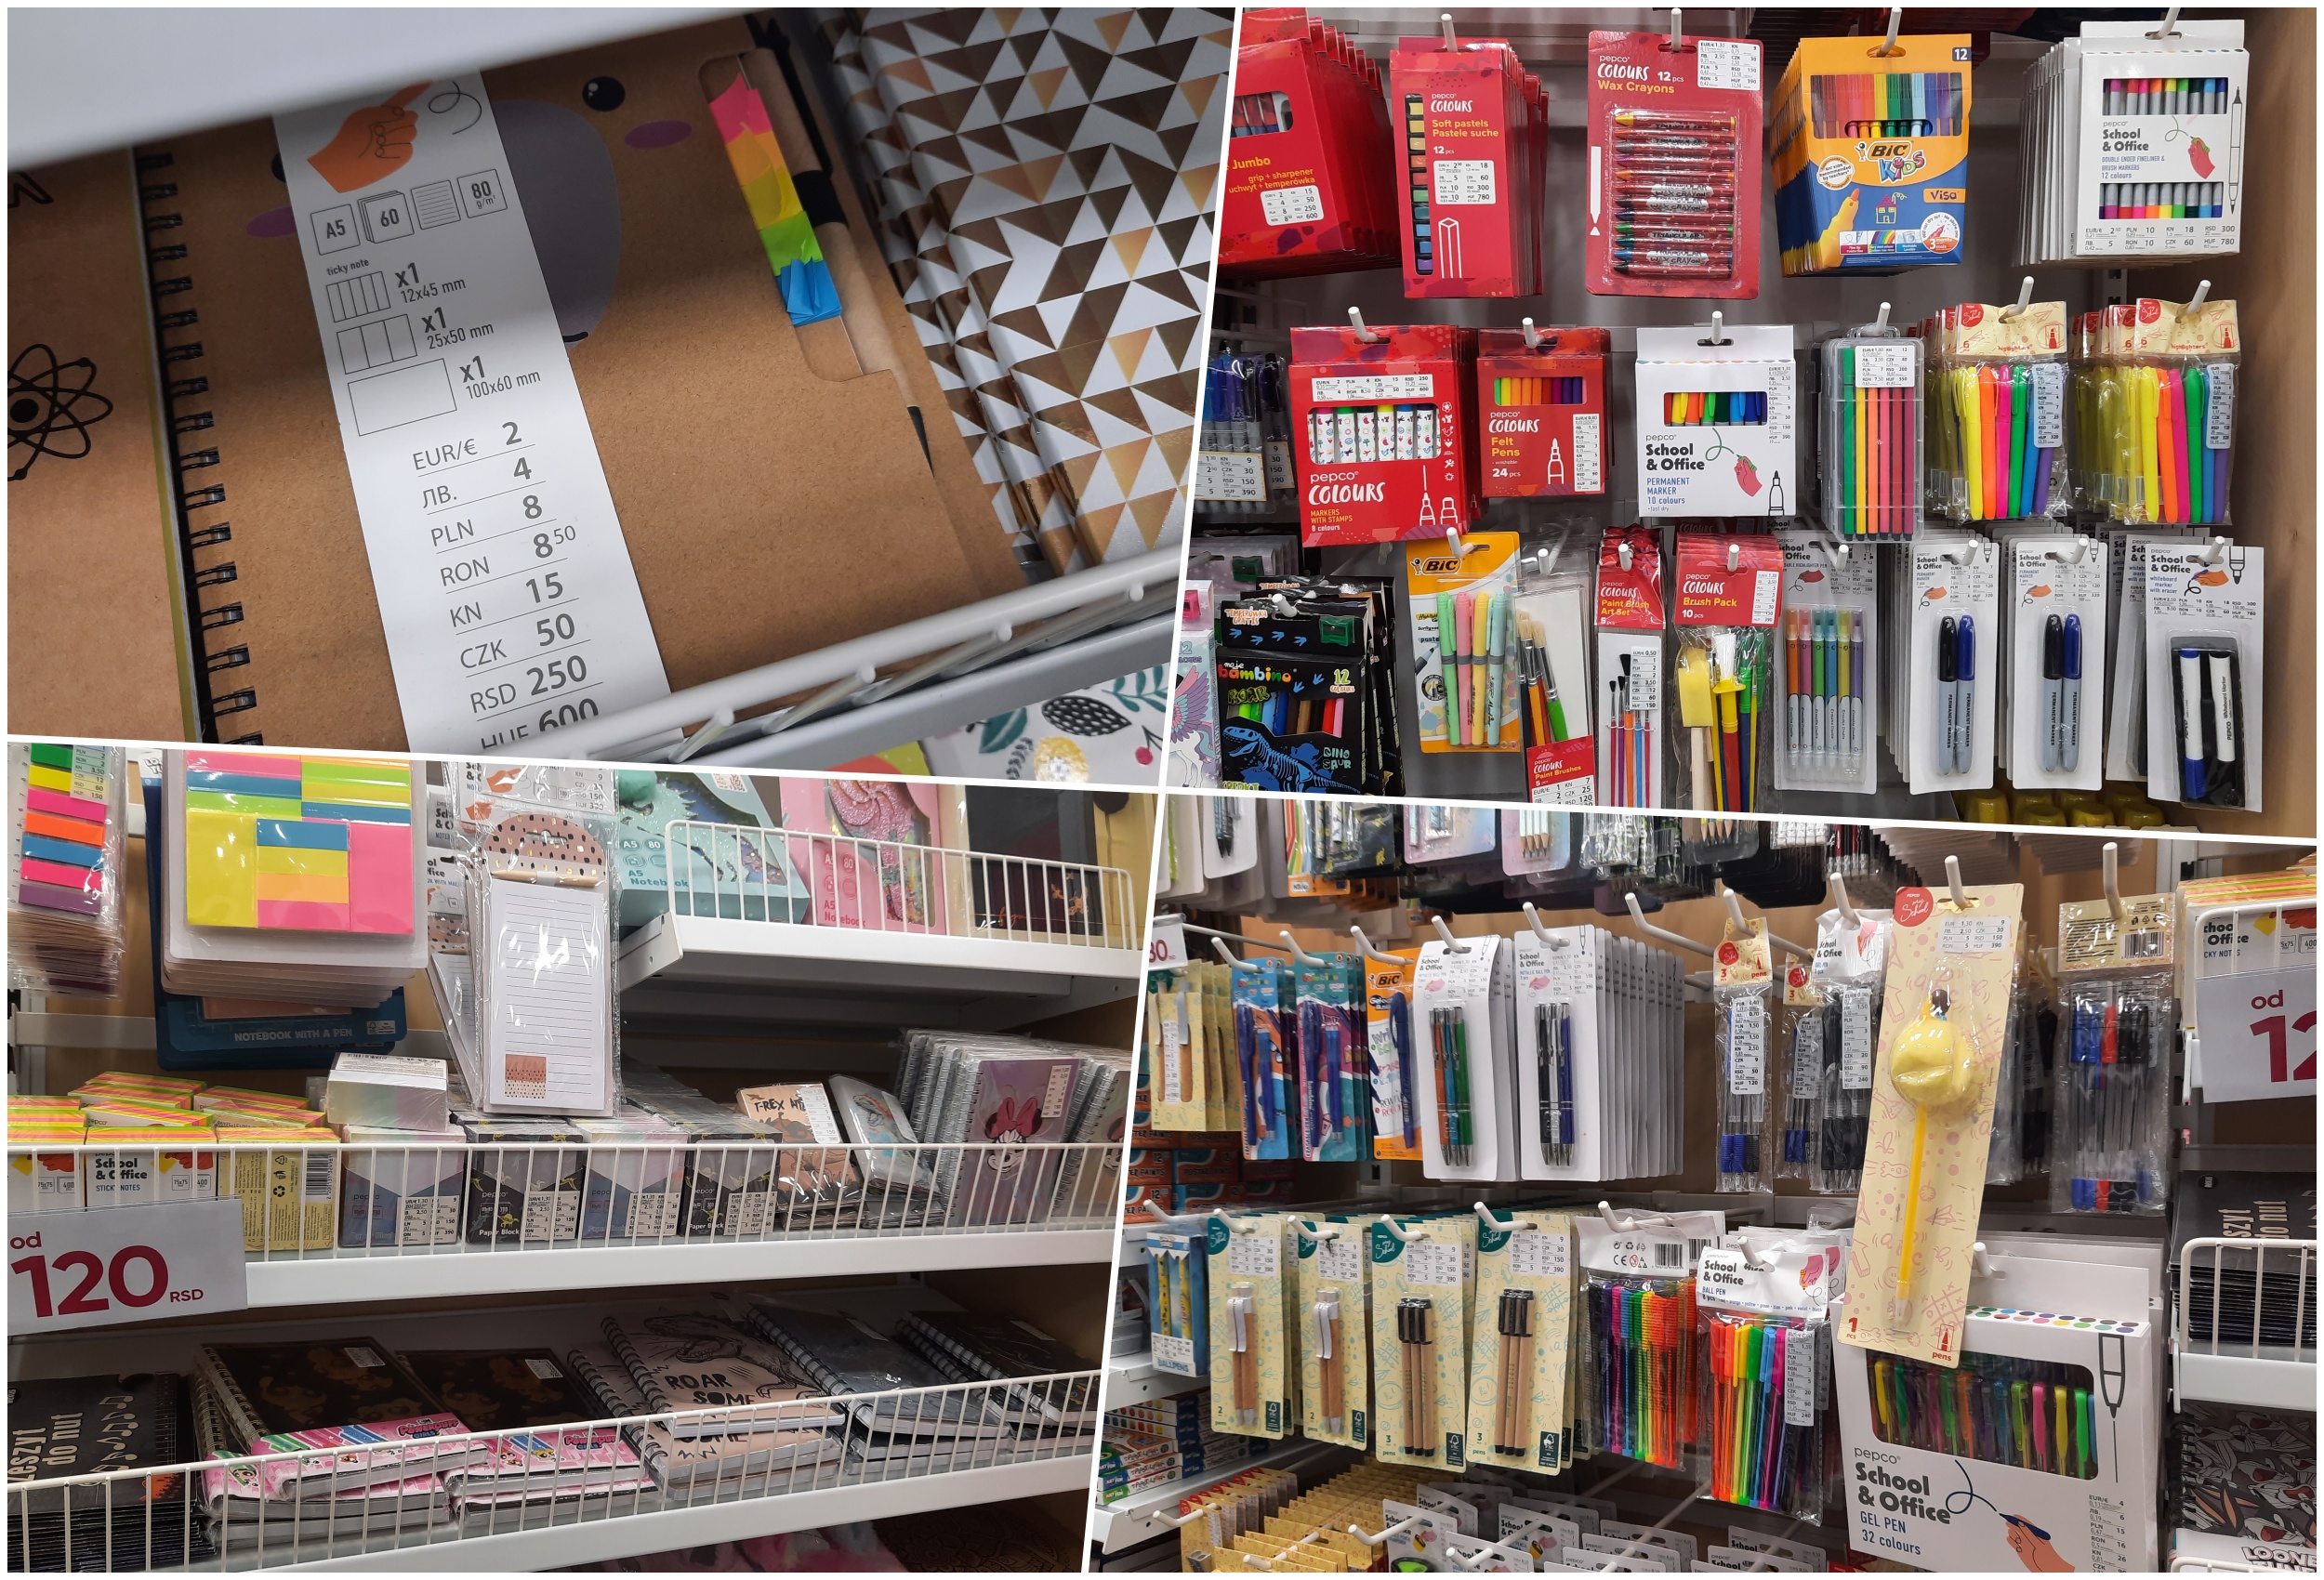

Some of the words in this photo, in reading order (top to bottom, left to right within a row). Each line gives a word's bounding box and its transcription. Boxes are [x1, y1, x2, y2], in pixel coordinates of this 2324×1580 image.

[1954, 48, 1967, 59] 12
[1597, 63, 1649, 81] COLOURS
[1657, 72, 1670, 81] 12
[1598, 80, 1623, 91] Wax
[1627, 81, 1674, 94] Crayons
[1431, 100, 1472, 113] COLOURS
[1432, 119, 1452, 128] Soft
[1454, 119, 1489, 129] pastels
[1433, 128, 1468, 138] Pastele
[1471, 129, 1499, 138] suche
[2103, 129, 2141, 139] School
[1433, 146, 1445, 154] 12
[2103, 142, 2111, 151] &
[2114, 141, 2149, 151] Office
[1232, 157, 1271, 170] Jumbo
[471, 180, 492, 199] 80
[1930, 191, 1957, 200] Visa
[380, 208, 400, 227] 60
[326, 219, 346, 240] A5
[326, 263, 348, 276] ticky
[350, 258, 369, 270] note
[395, 262, 419, 287] x1
[401, 284, 438, 303] 12x45
[442, 278, 466, 294] mm
[421, 307, 447, 334] x1
[427, 328, 466, 349] 25x50
[469, 323, 494, 336] mm
[459, 356, 485, 383] x1
[466, 374, 513, 400] 100x60
[516, 370, 541, 387] mm
[1489, 419, 1539, 433] COLOURS
[413, 439, 478, 470] EUR/€
[502, 421, 522, 445] 2
[1491, 437, 1513, 446] Felt
[1492, 448, 1520, 457] Pens
[1646, 443, 1693, 456] School
[1646, 459, 1657, 470] &
[1660, 458, 1705, 470] Office
[1310, 471, 1356, 483] pepco
[1493, 468, 1508, 478] 24
[422, 485, 456, 508] ЛВ.
[513, 457, 532, 480] 4
[1309, 482, 1386, 505] COLOURS
[1647, 486, 1677, 494] MARKER
[1657, 496, 1685, 506] colours
[430, 520, 474, 546] PLN
[522, 494, 542, 519] 8
[2151, 555, 2184, 564] School
[440, 557, 490, 586] RON
[2160, 565, 2191, 573] Office
[1601, 586, 1637, 598] COLOURS
[1683, 581, 1725, 595] COLOURS
[450, 602, 482, 627] KN
[525, 573, 563, 603] 15
[1684, 598, 1710, 606] Brush
[1713, 599, 1737, 607] Pack
[460, 639, 508, 669] CZK
[536, 613, 575, 647] 50
[1218, 665, 1292, 682] bambino
[1333, 669, 1351, 685] 12
[470, 683, 517, 714] RSD
[526, 655, 587, 695] 250
[1330, 685, 1355, 693] COLOURS
[1323, 747, 1350, 758] DINO
[1323, 758, 1352, 770] SAUR
[1534, 760, 1563, 773] COLOURS
[1535, 771, 1553, 780] Paint
[1554, 765, 1582, 776] Brushes
[623, 839, 638, 849] A5
[648, 840, 660, 849] 80
[1900, 903, 1928, 922] School
[1817, 949, 1823, 957] &
[1825, 949, 1842, 957] Office
[1751, 971, 1767, 980] pens
[2251, 990, 2283, 1009] od
[234, 1031, 292, 1042] NOTEBOOK
[295, 1030, 318, 1038] WITH
[321, 1029, 331, 1038] A
[333, 1027, 352, 1037] PEN
[755, 1099, 786, 1112] T-REX
[10, 1231, 42, 1250] od
[1705, 1260, 1737, 1272] School
[10, 1244, 168, 1318] 120
[169, 1288, 204, 1303] RSD
[1703, 1271, 1710, 1282] &
[1712, 1273, 1744, 1285] Office
[1848, 1318, 1858, 1333] 1
[1932, 1351, 1952, 1362] pens
[665, 1374, 733, 1389] ROAR
[50, 1412, 83, 1439] nut
[42, 1444, 75, 1467] do
[1855, 1447, 1897, 1465] pepco
[1855, 1462, 1930, 1495] School
[1858, 1486, 1874, 1507] &
[1880, 1492, 1950, 1524] Office
[1860, 1511, 1881, 1527] GEL
[1884, 1517, 1906, 1534] PEN
[1862, 1530, 1876, 1545] 32
[1879, 1535, 1921, 1556] colours
